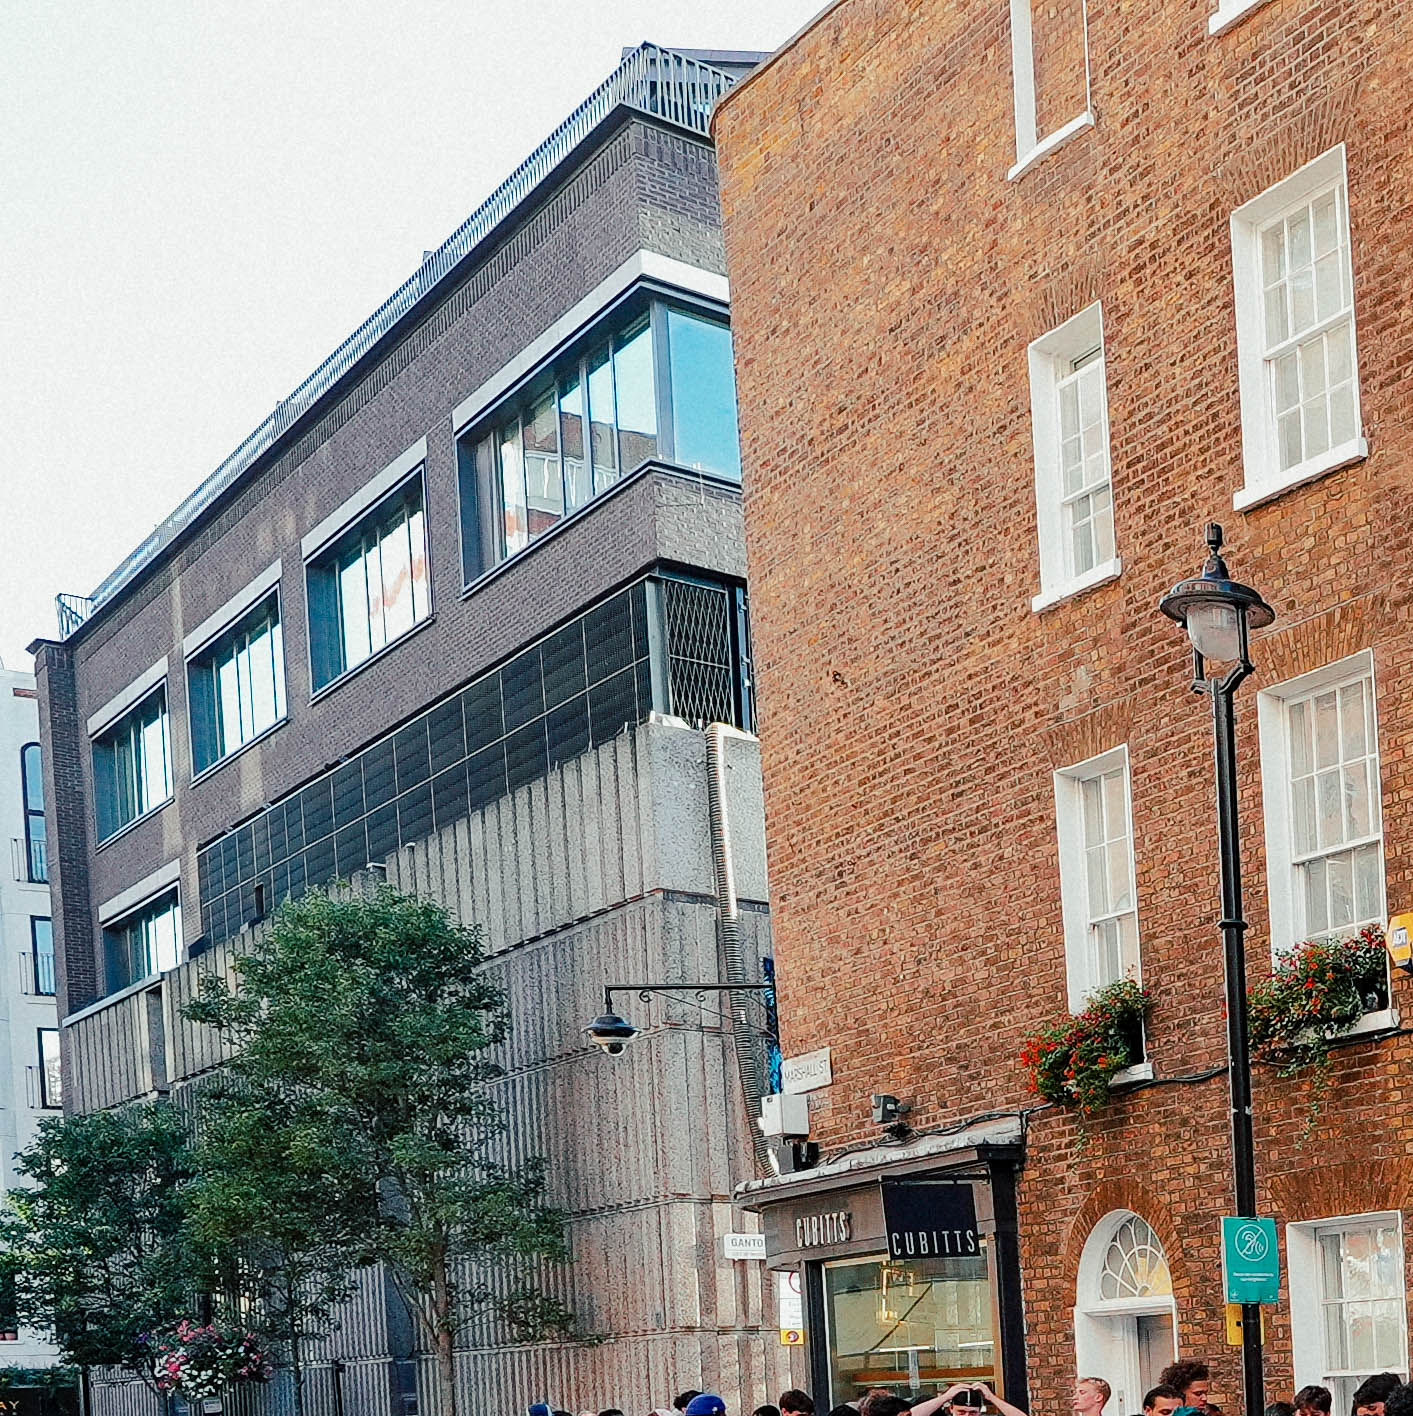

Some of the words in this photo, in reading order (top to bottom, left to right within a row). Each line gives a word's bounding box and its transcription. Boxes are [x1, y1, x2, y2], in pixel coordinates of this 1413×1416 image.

[731, 1238, 763, 1247] GANTO
[796, 1212, 848, 1247] CUBITTS
[891, 1229, 976, 1256] CUBITTS
